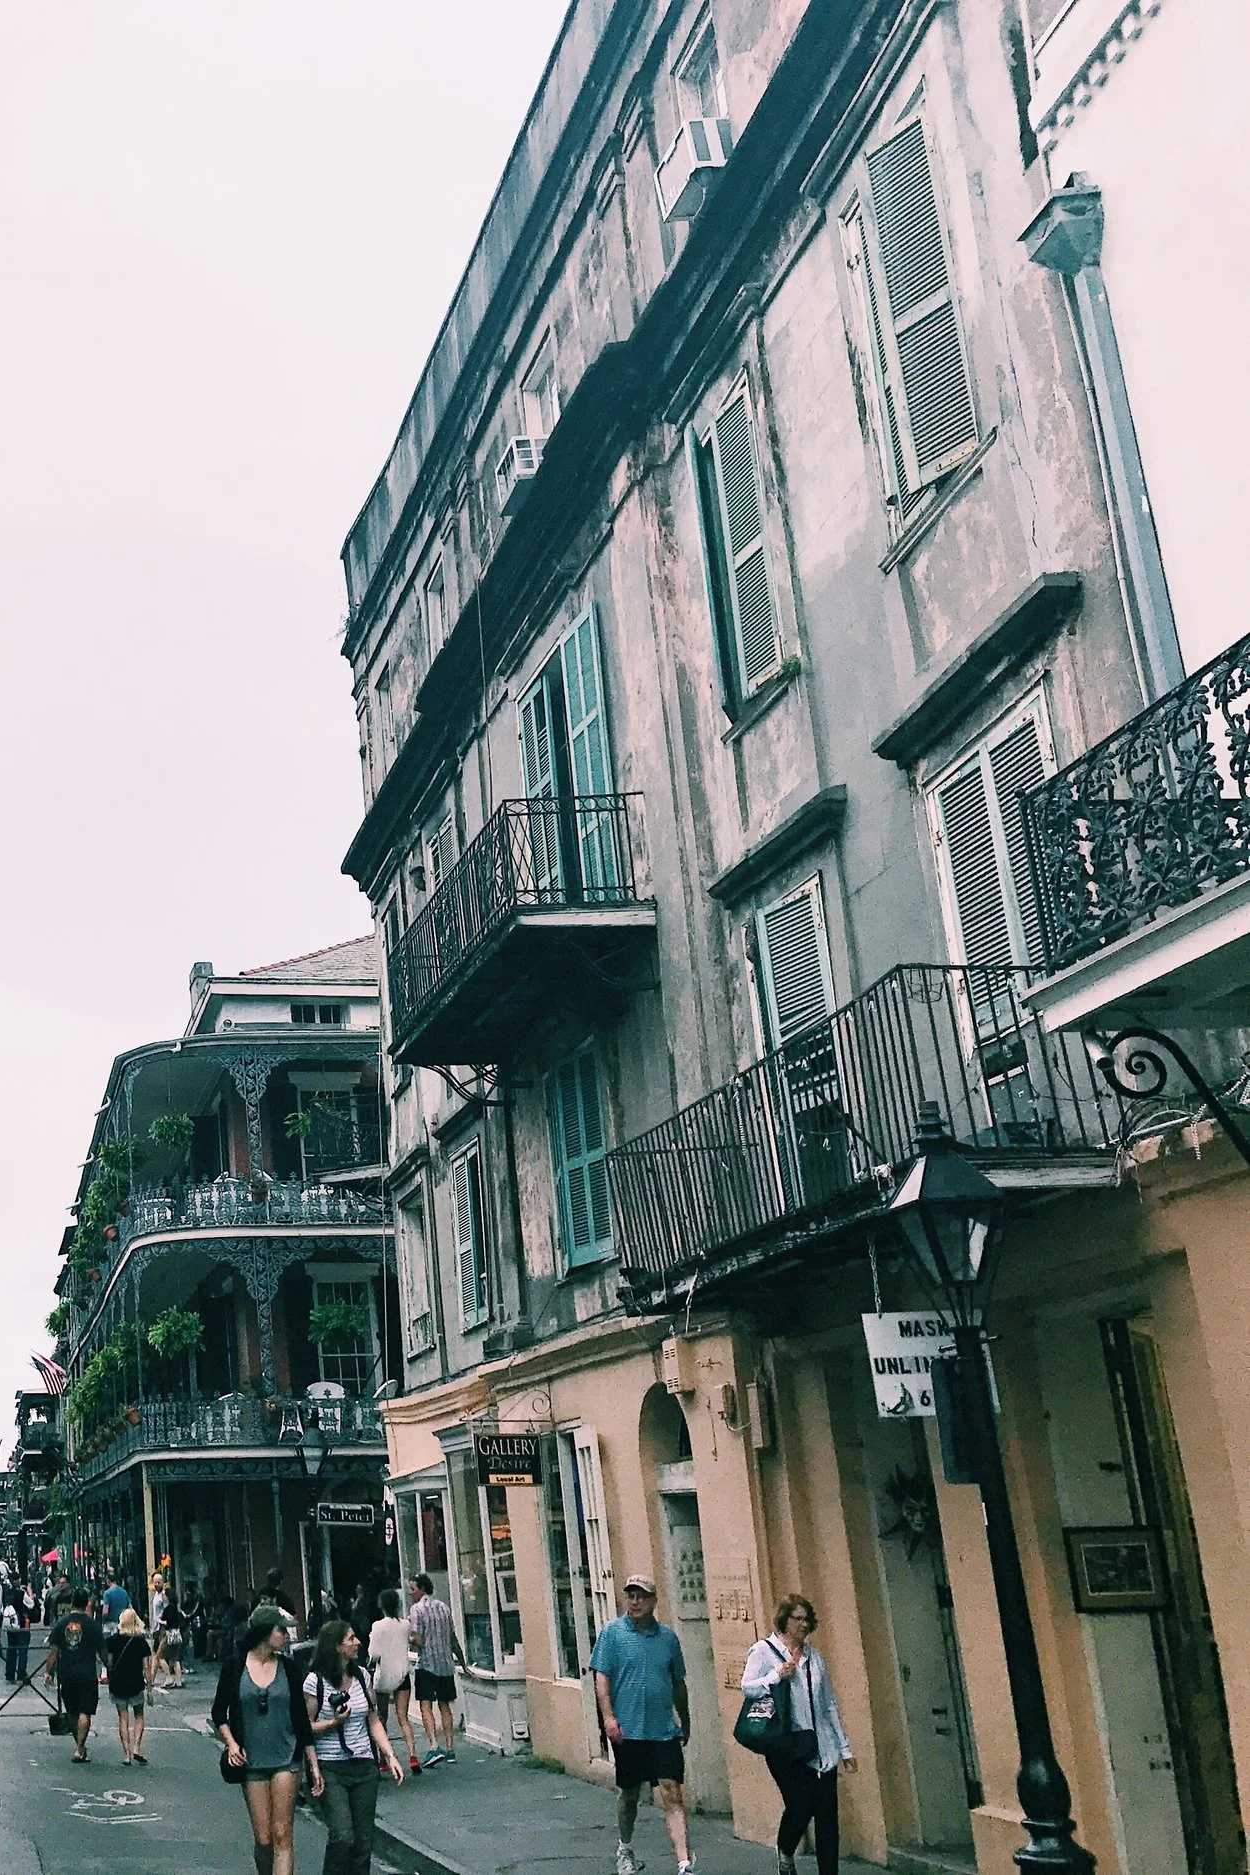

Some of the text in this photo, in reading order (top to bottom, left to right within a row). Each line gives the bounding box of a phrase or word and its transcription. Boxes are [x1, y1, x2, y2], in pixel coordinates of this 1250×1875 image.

[478, 1436, 537, 1455] GALLERY
[487, 1456, 532, 1470] Desire
[320, 1511, 370, 1521] St. Peter
